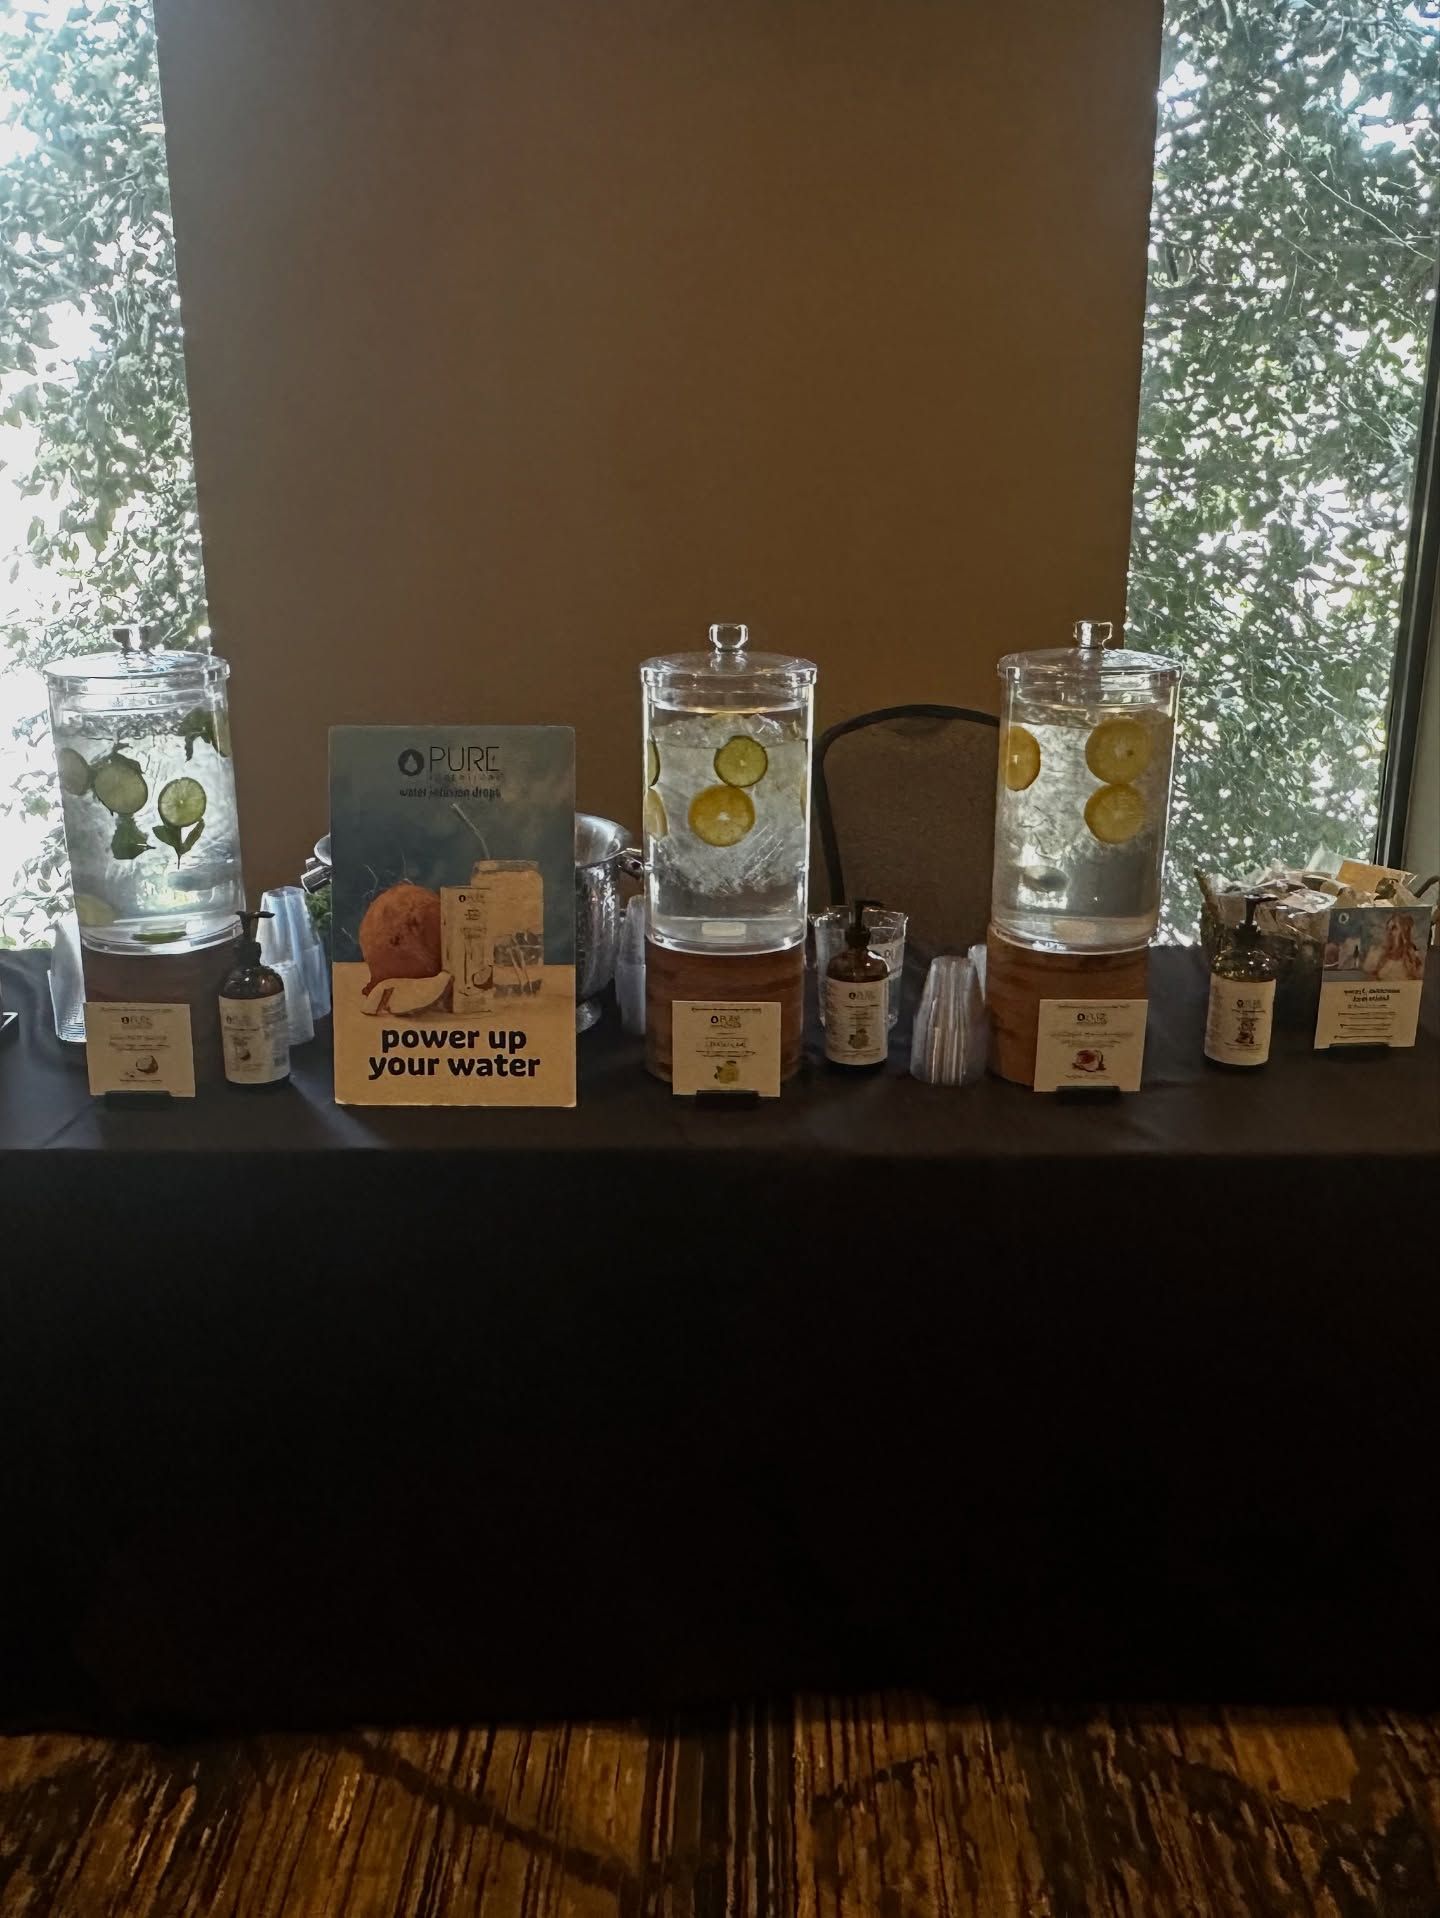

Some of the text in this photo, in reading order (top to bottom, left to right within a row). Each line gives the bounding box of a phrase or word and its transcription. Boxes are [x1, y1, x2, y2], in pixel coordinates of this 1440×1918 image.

[429, 746, 500, 772] PURE
[381, 1029, 527, 1054] power up
[368, 1054, 541, 1080] your water
